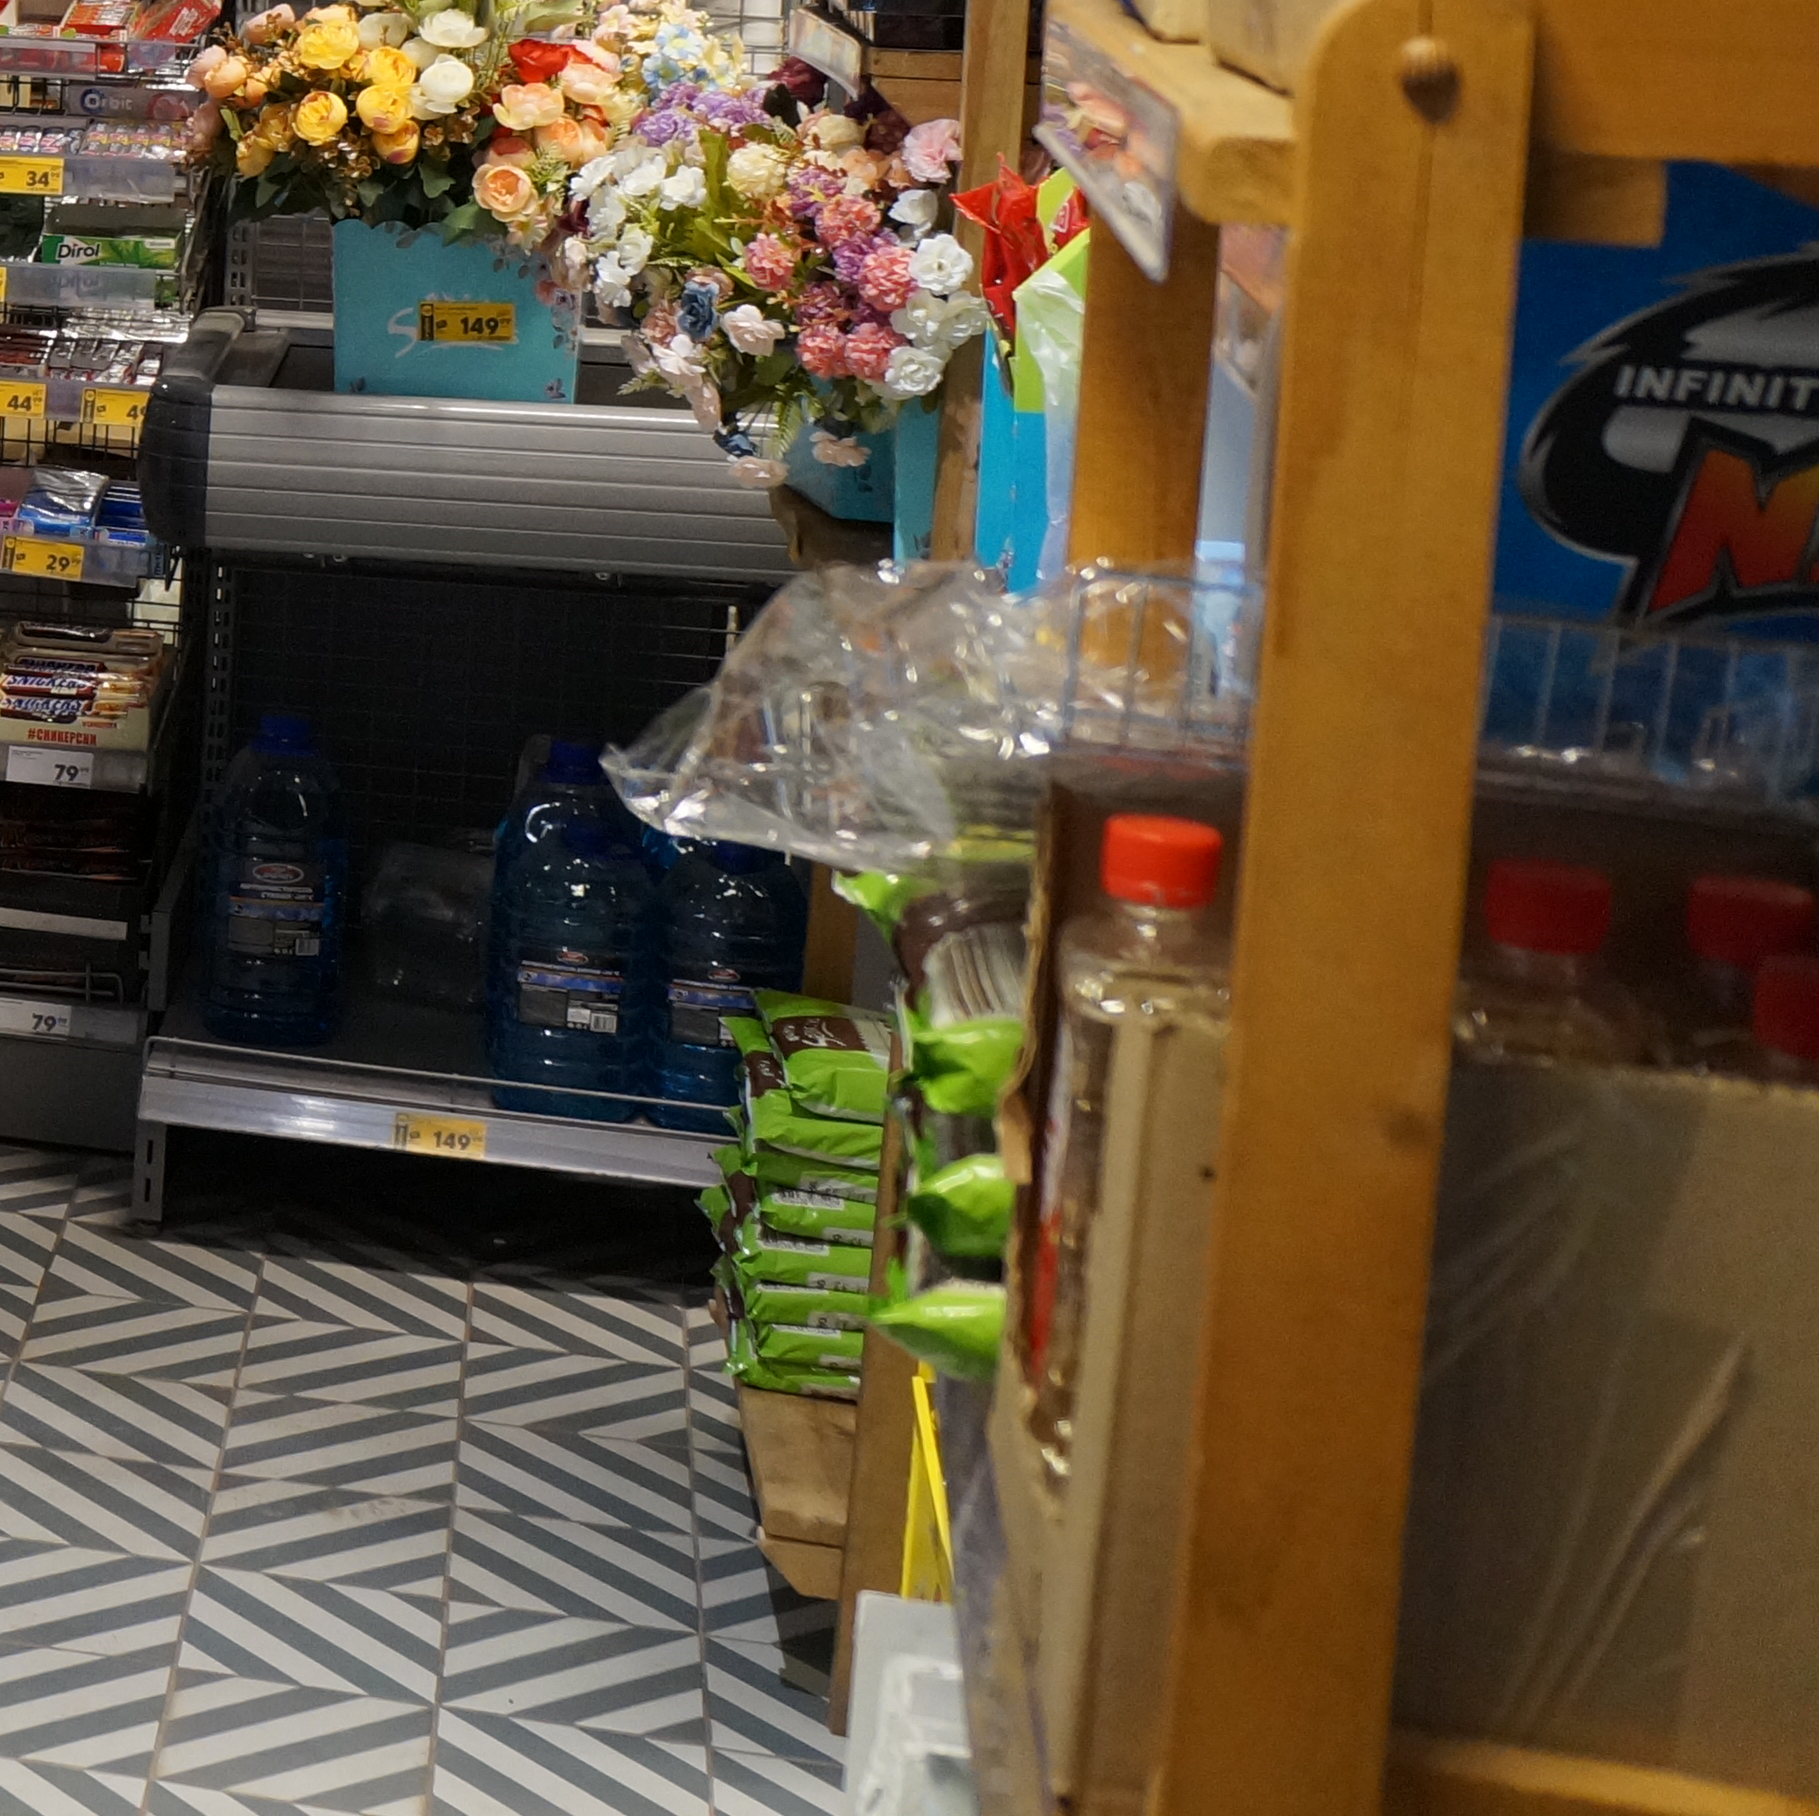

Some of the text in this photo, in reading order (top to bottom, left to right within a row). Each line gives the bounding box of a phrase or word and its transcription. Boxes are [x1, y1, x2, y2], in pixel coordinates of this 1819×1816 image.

[27, 170, 51, 187] 34
[57, 241, 100, 261] Dirol
[458, 315, 499, 335] 149
[6, 394, 32, 412] 44
[45, 554, 69, 572] 29
[53, 763, 79, 782] 79
[31, 1013, 57, 1031] 79
[431, 1130, 471, 1152] 149
